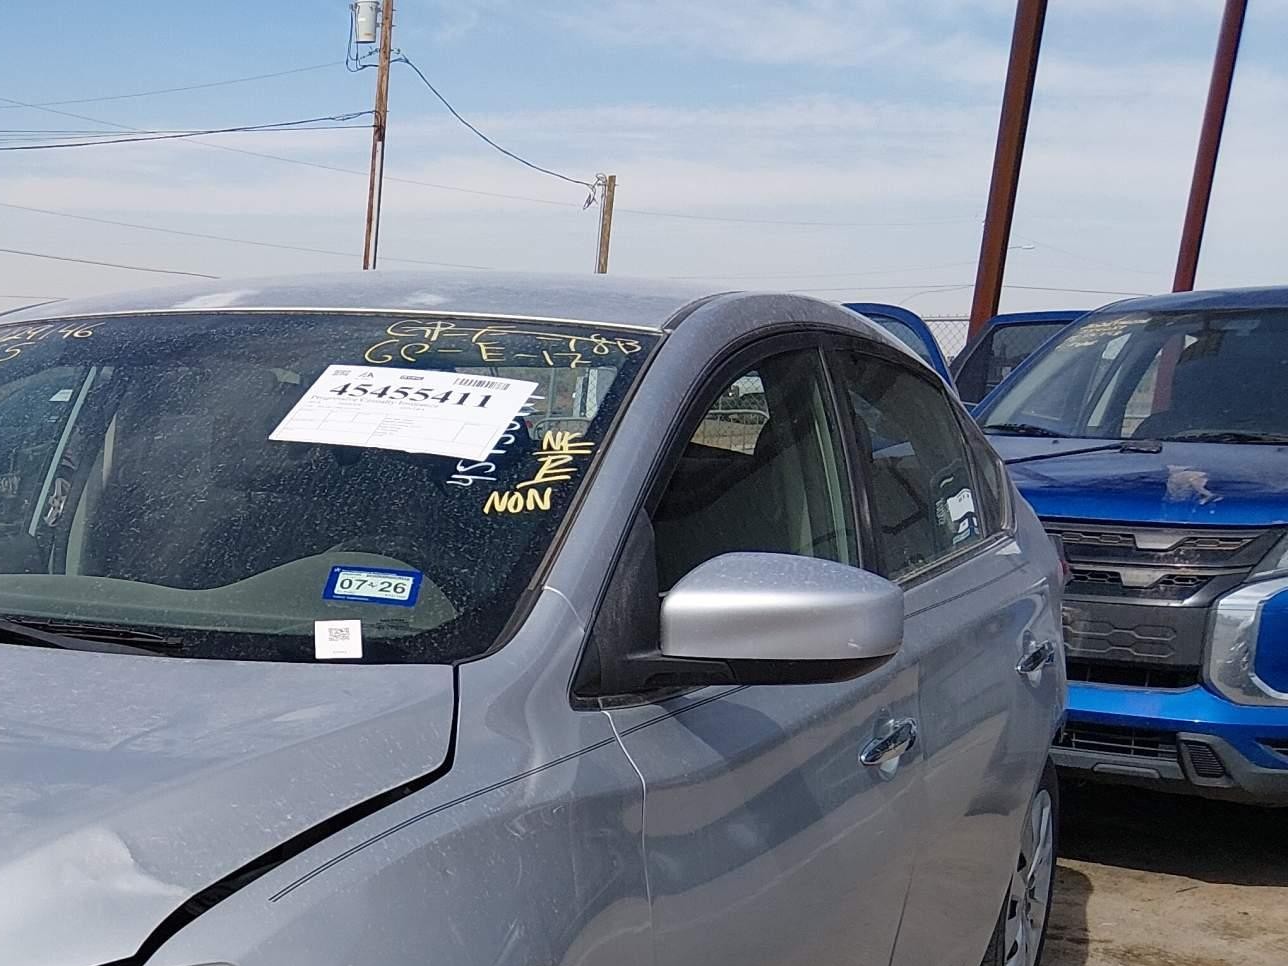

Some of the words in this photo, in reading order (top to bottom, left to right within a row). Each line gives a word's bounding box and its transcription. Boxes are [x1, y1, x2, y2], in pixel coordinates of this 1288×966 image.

[329, 382, 492, 408] 45455411
[483, 487, 552, 514] NON
[340, 578, 368, 591] 07
[378, 581, 407, 594] 26
